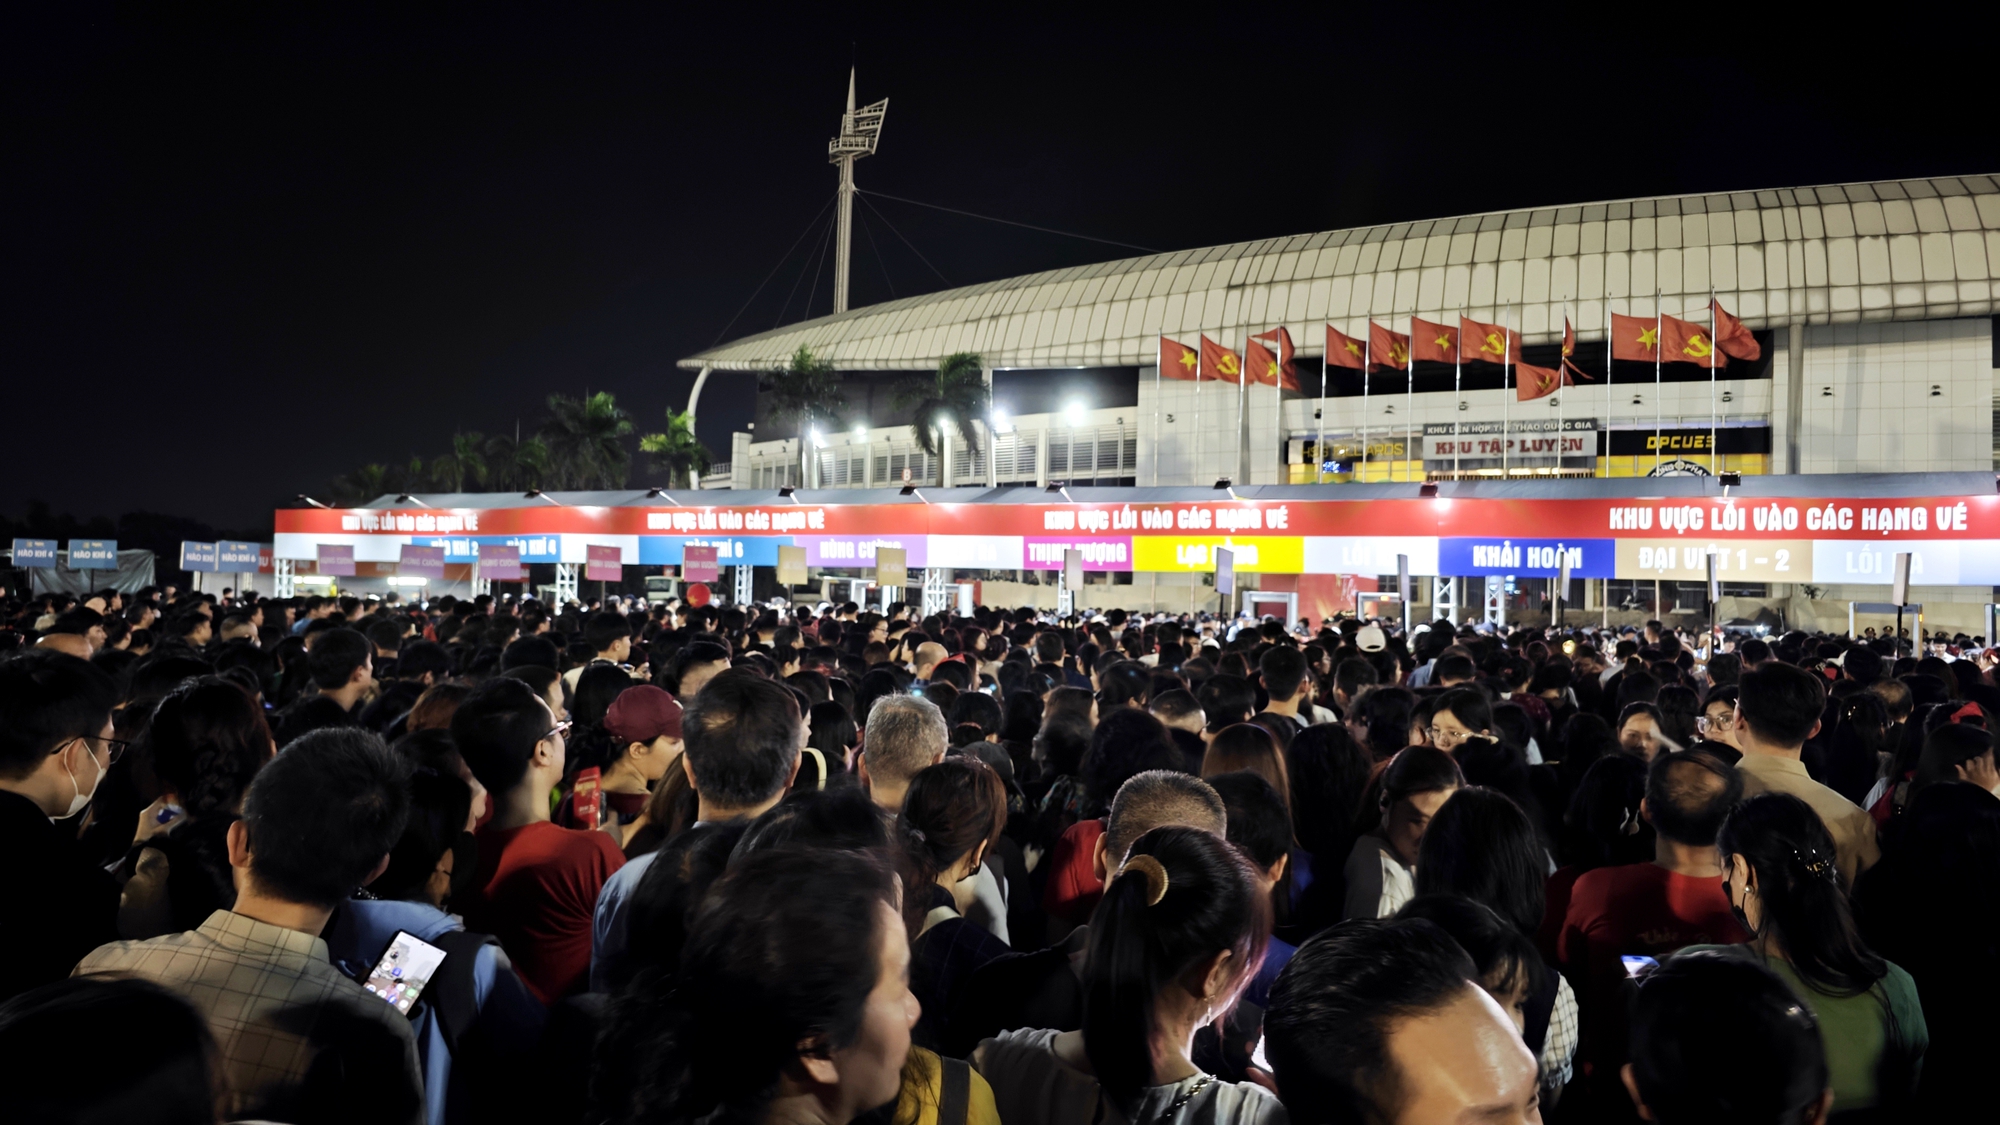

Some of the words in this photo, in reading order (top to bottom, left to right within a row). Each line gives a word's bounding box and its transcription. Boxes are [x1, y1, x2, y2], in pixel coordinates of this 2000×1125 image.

[1448, 425, 1469, 434] LN
[1574, 421, 1592, 430] GIA
[1333, 443, 1404, 458] BILLARDS
[1044, 510, 1075, 530] KHU
[1078, 510, 1109, 533] VỰC
[1141, 506, 1174, 530] VÀO
[1177, 506, 1212, 530] CÁC
[1215, 508, 1262, 533] HẠNG
[1265, 505, 1289, 530] VÉ
[1609, 507, 1653, 531] KHU
[1659, 505, 1704, 535] VỰC
[1711, 499, 1746, 531] LỐI
[1753, 504, 1798, 532] VÀO
[1806, 503, 1853, 531] CÁC
[1861, 506, 1928, 535] HẠNG
[1936, 502, 1968, 531] VÉ
[47, 550, 54, 558] 4
[106, 551, 113, 559] 6
[471, 540, 479, 556] 2
[547, 539, 557, 556] 4
[734, 541, 744, 559] 6
[1473, 540, 1521, 568] KHẢI
[1638, 546, 1677, 572] ĐẠI
[1736, 548, 1746, 571] 1
[1774, 548, 1790, 572] 2
[1846, 543, 1883, 574] LỐI
